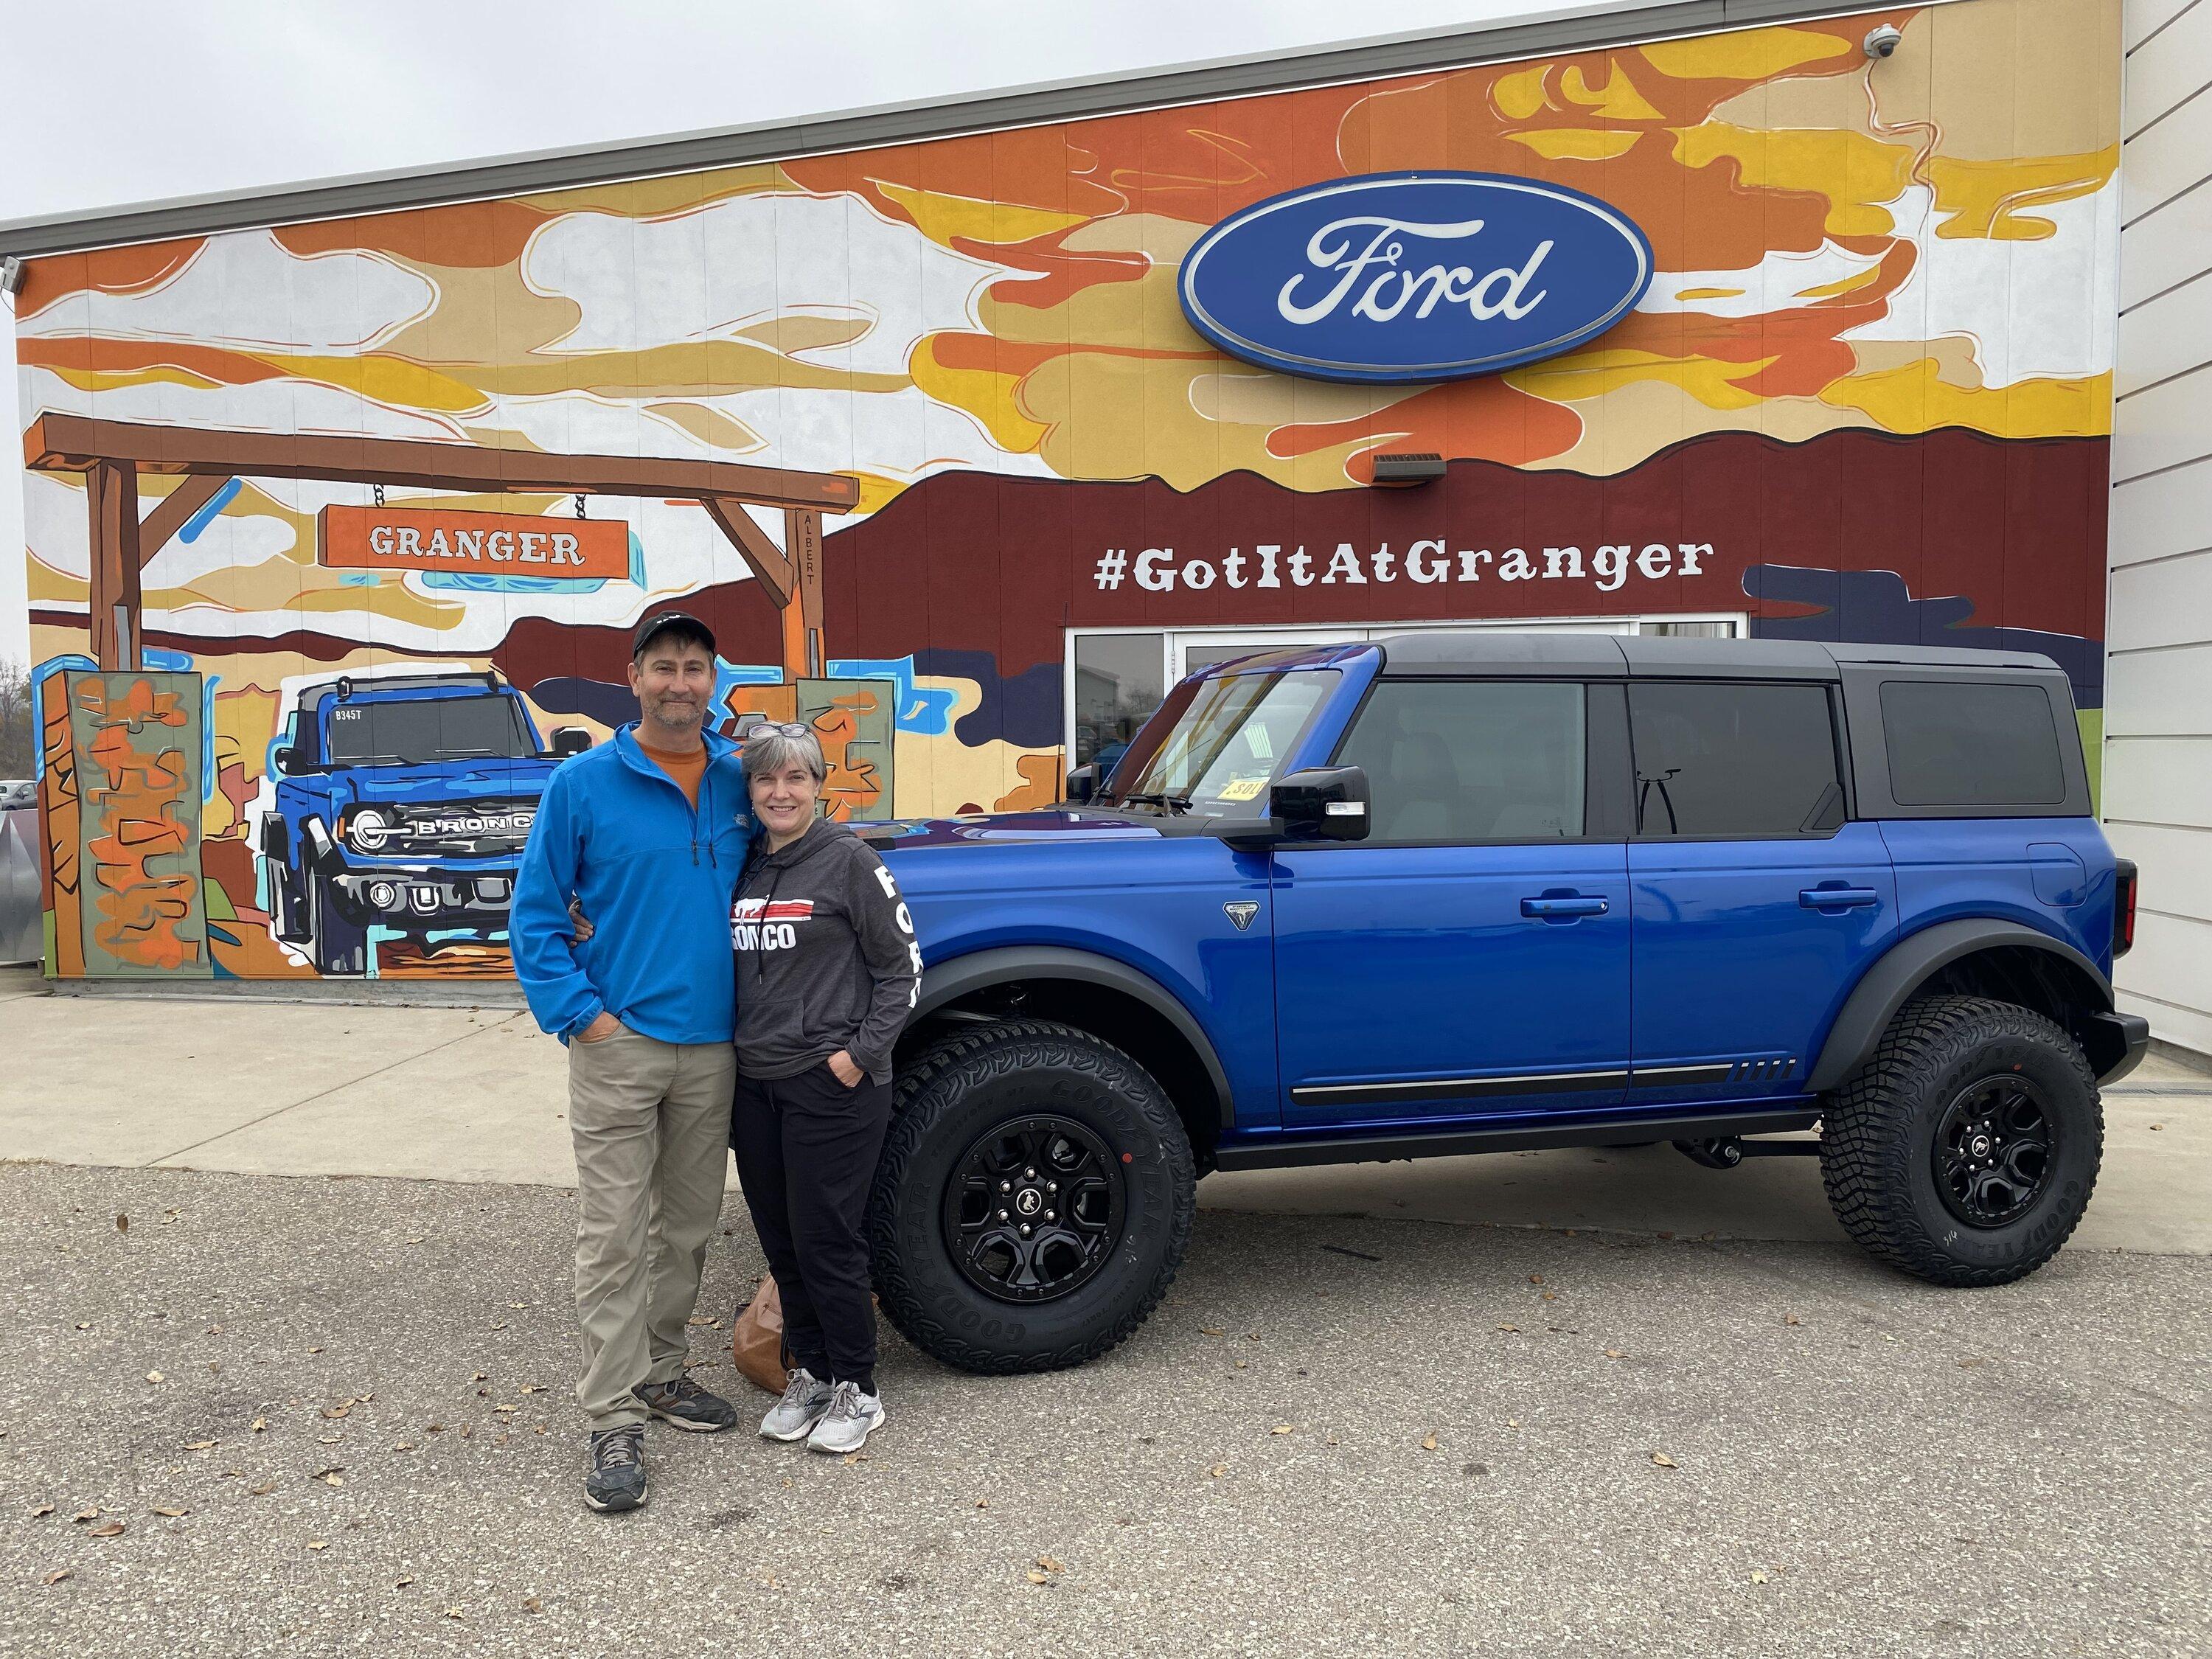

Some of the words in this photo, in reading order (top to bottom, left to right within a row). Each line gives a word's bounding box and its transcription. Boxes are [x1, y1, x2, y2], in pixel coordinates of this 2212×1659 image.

[1277, 215, 1554, 325] Ford
[369, 526, 586, 566] GRANGER
[804, 515, 815, 585] ALBERT
[1093, 538, 1715, 592] #GotItAtGranger
[417, 814, 534, 835] BRONC
